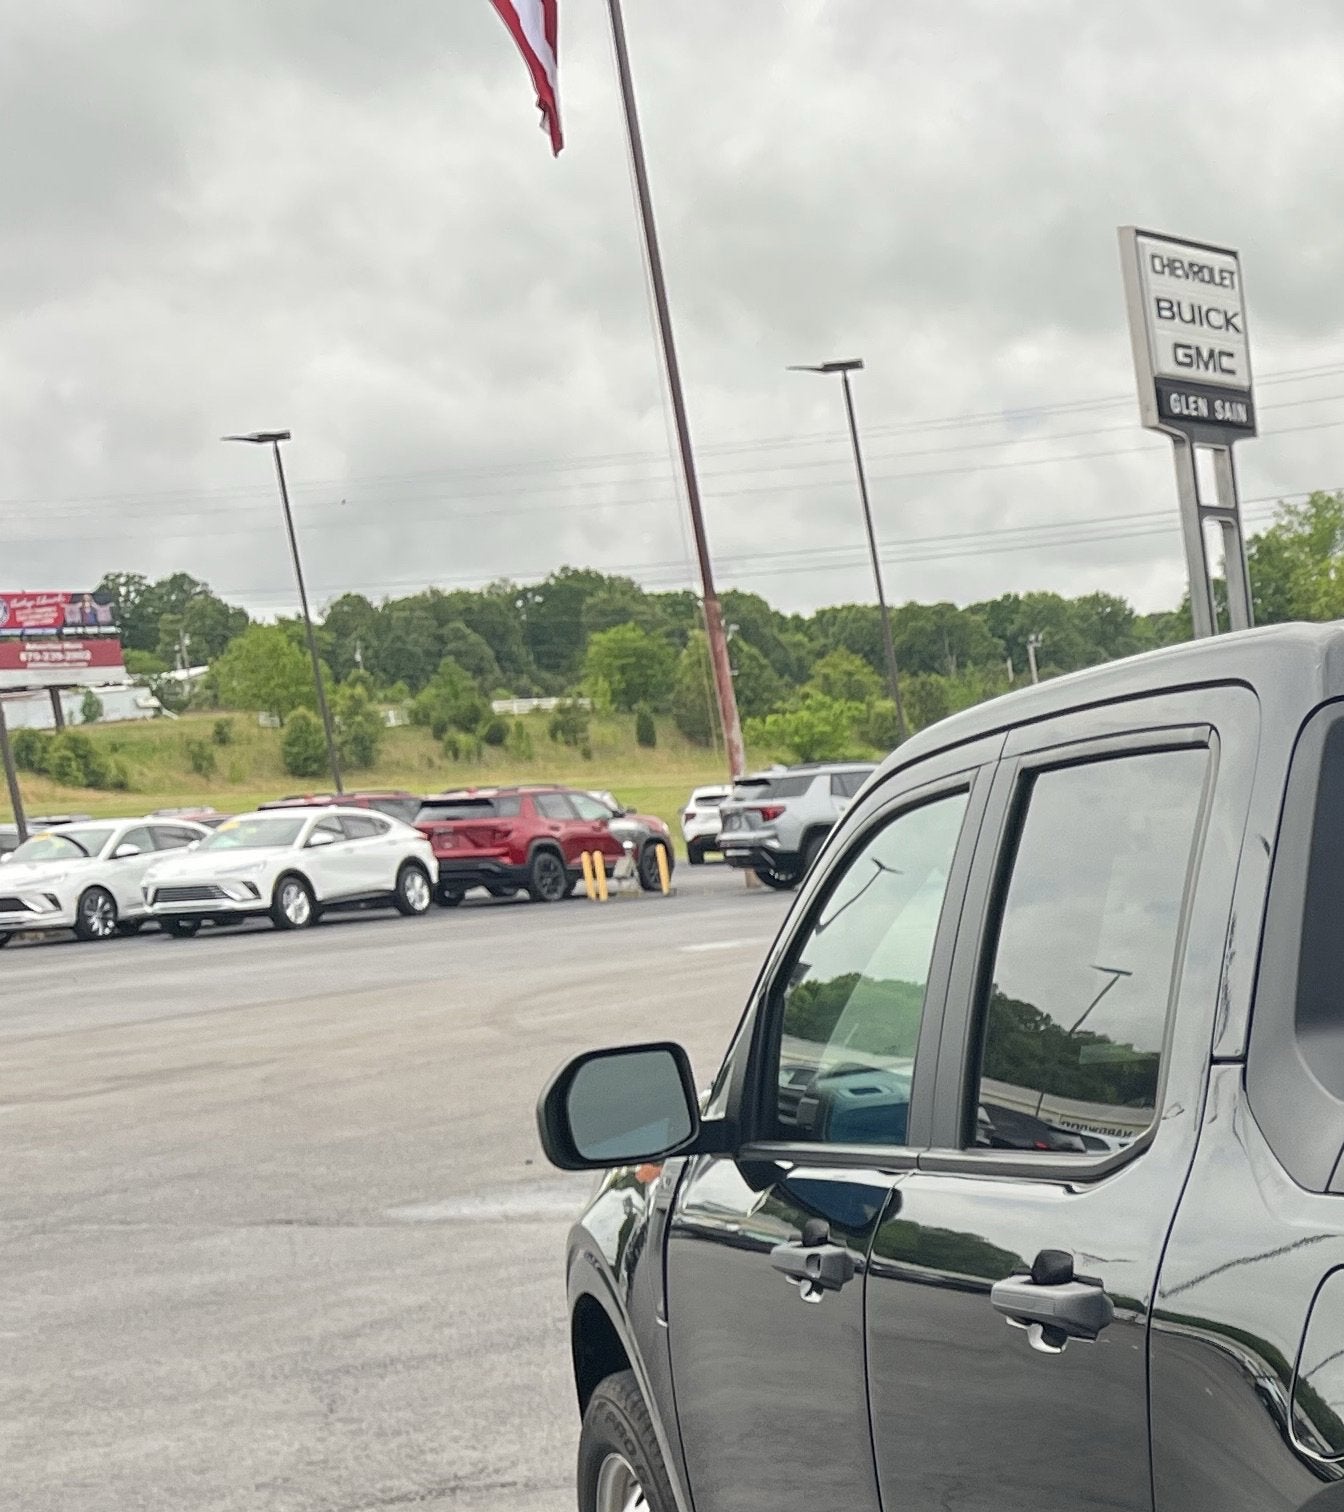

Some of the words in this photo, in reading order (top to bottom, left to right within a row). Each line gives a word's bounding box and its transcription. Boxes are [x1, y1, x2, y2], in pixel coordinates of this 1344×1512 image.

[1150, 253, 1236, 291] CHEVROLET
[1155, 297, 1242, 334] BUICK
[1173, 342, 1237, 375] GMC
[1169, 392, 1209, 418] GLEN
[1214, 399, 1248, 423] SAIN
